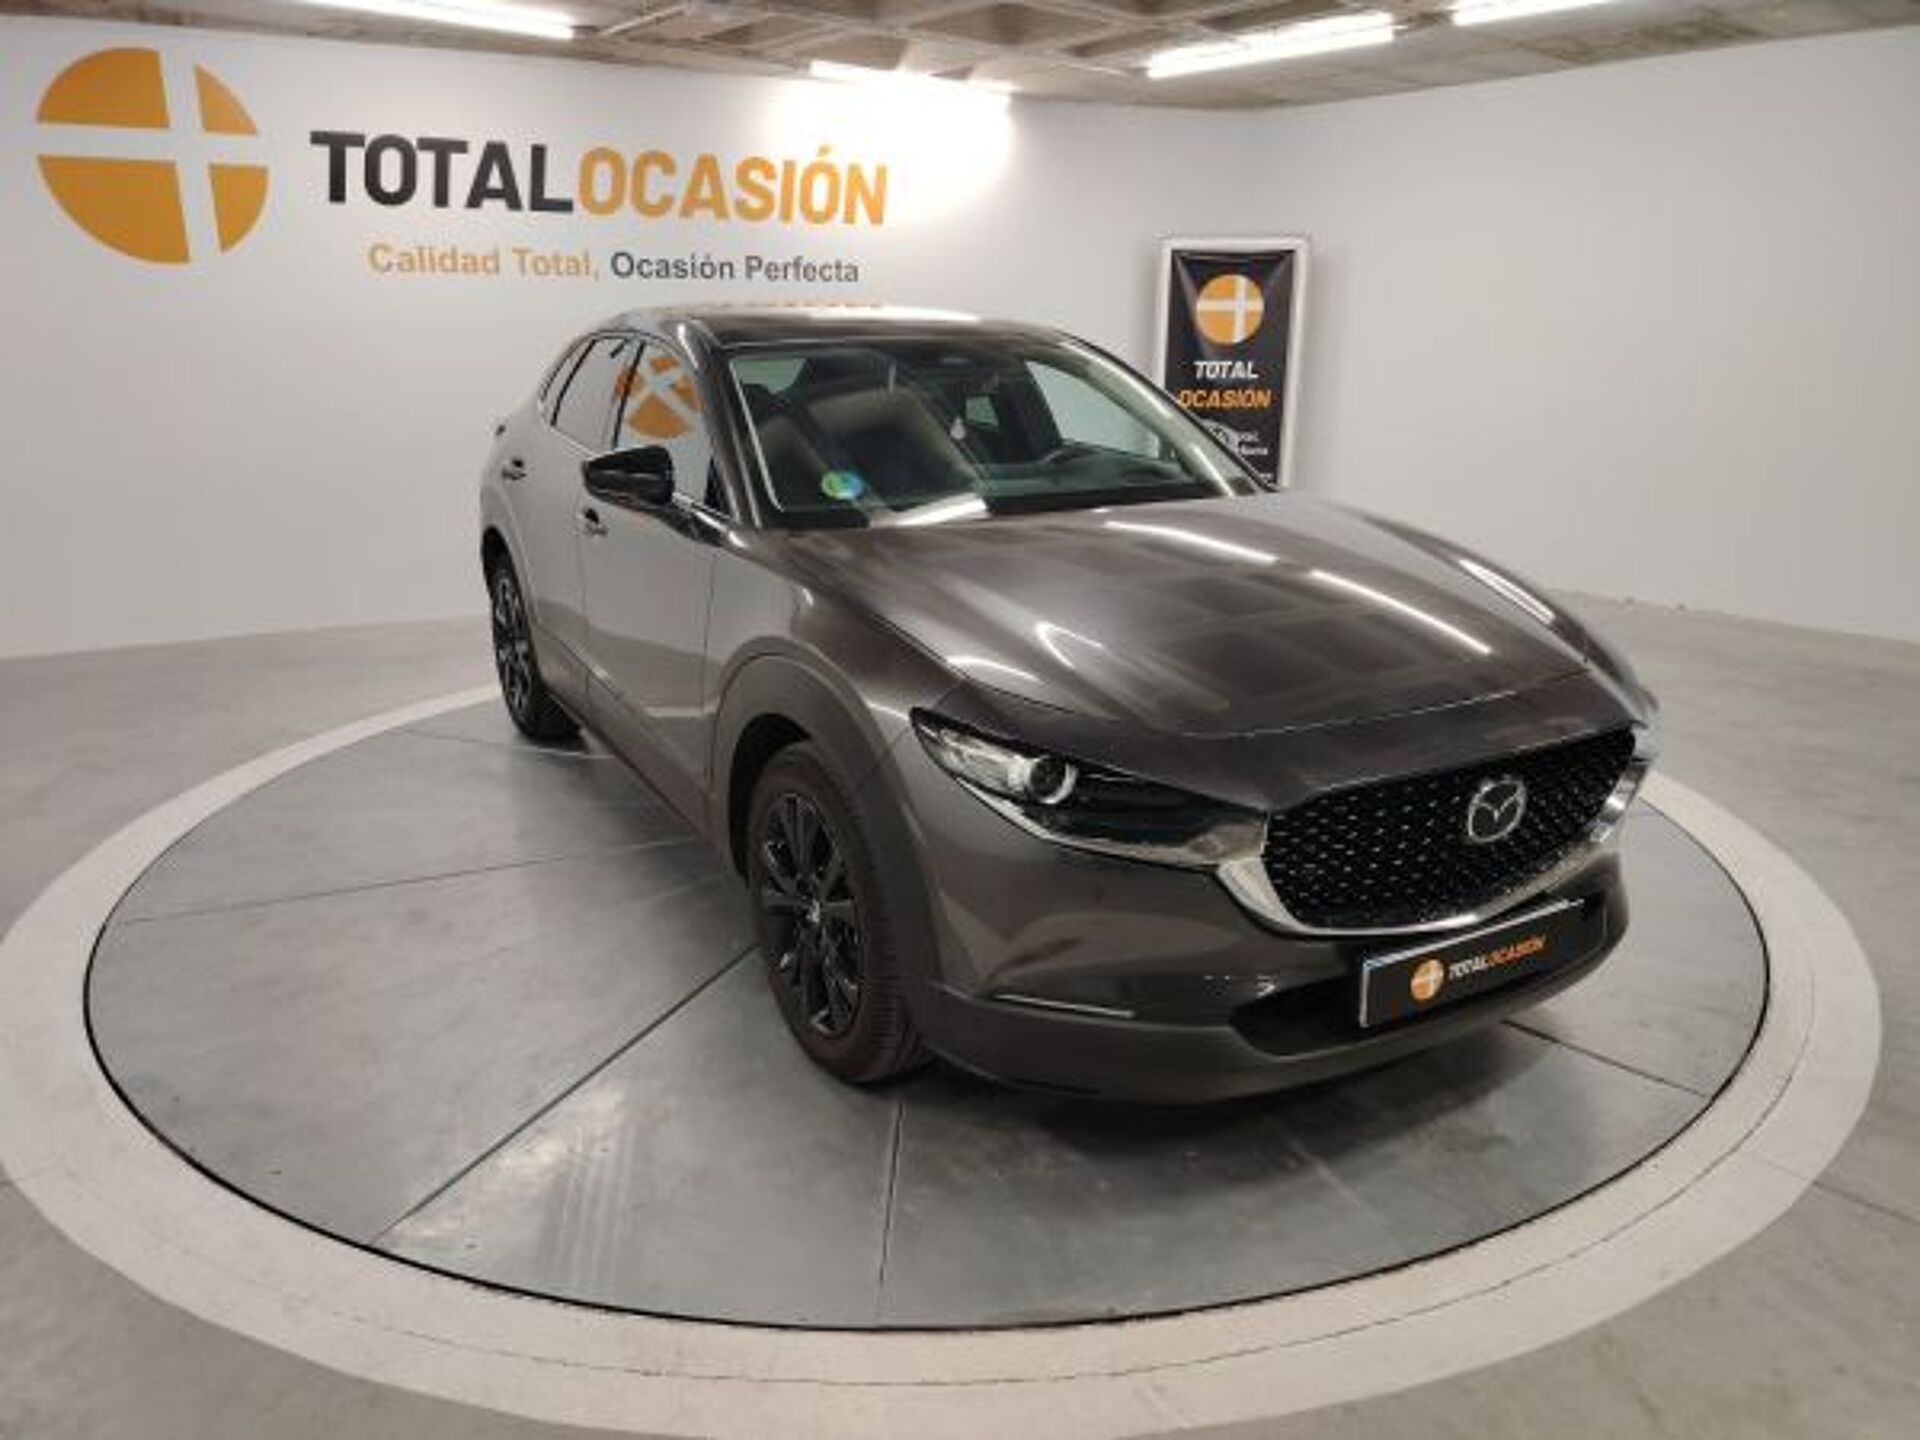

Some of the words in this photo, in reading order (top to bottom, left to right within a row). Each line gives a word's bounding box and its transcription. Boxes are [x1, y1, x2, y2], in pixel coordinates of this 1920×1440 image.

[367, 241, 501, 278] Calidad
[512, 247, 601, 282] Total,
[610, 252, 736, 281] Ocasión
[744, 256, 860, 284] Perfecta
[1193, 360, 1260, 379] TOTAL
